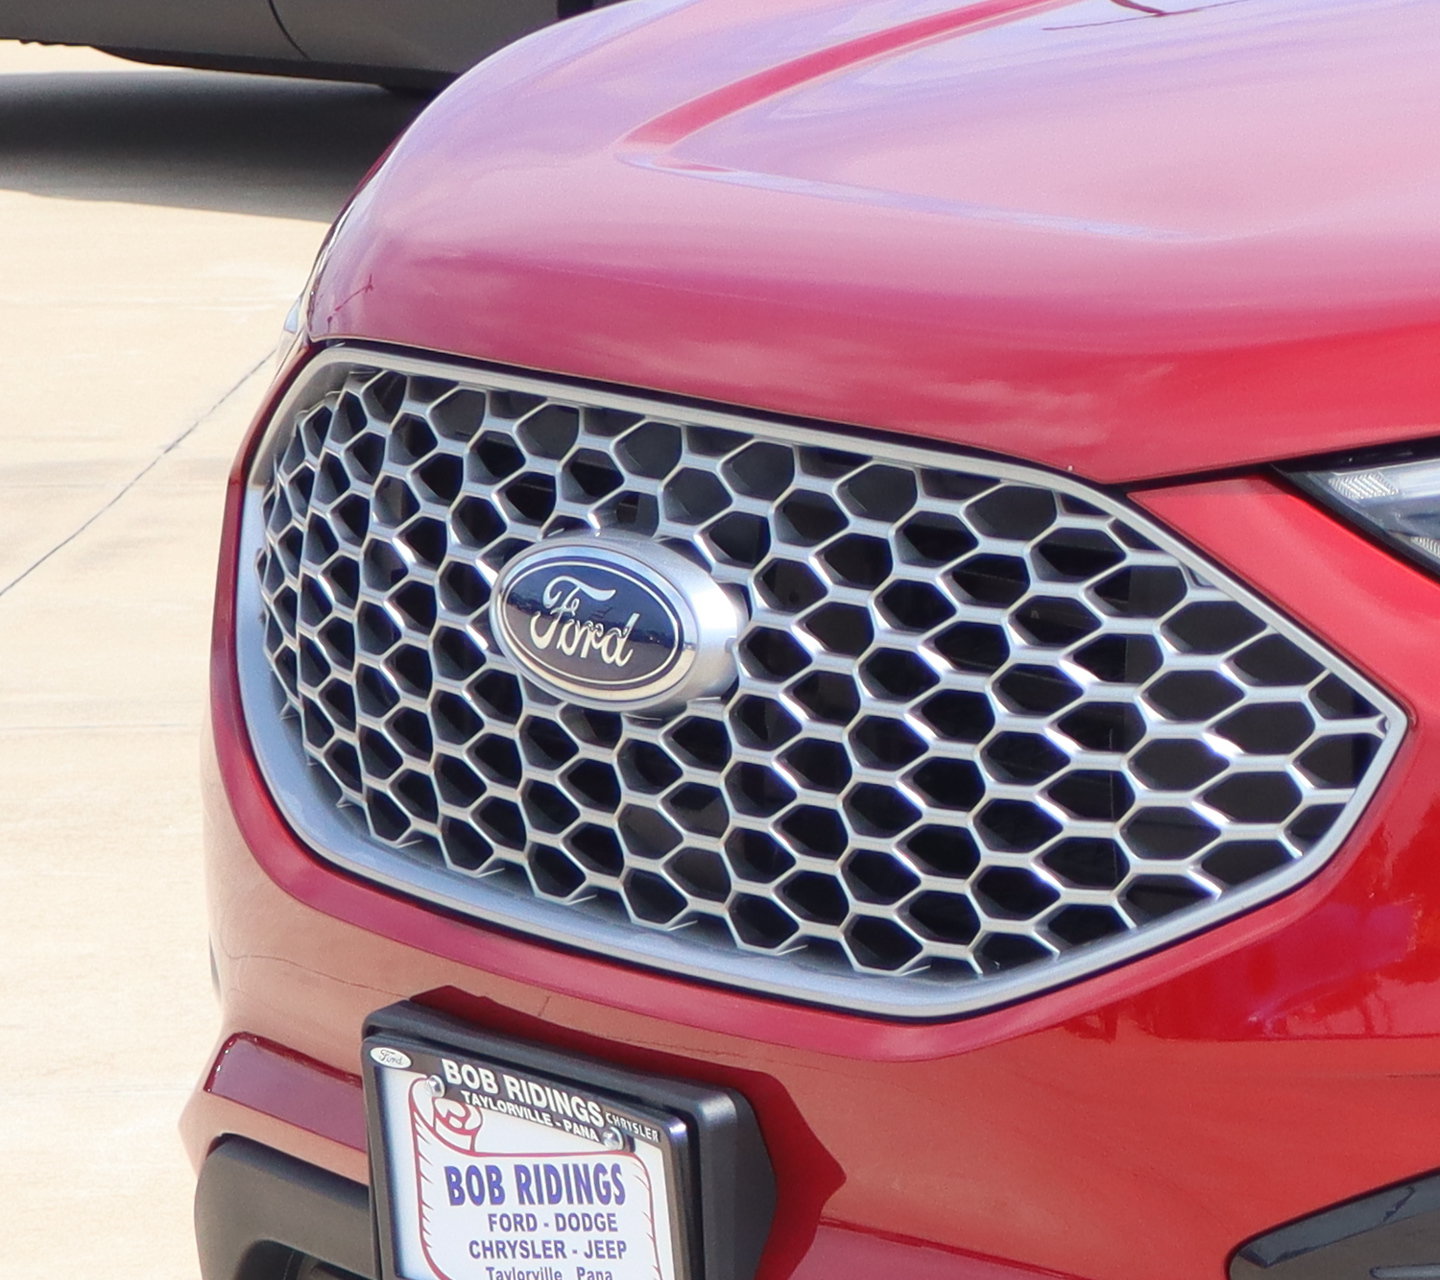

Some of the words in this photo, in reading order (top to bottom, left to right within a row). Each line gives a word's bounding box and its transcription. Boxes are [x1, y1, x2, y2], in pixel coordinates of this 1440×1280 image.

[529, 575, 640, 668] Ford
[378, 1049, 404, 1065] Ford
[442, 1058, 499, 1094] BOB
[503, 1074, 605, 1128] RIDINGS
[461, 1090, 553, 1127] TAYLORVILLE
[565, 1120, 599, 1142] PANA
[605, 1112, 660, 1144] CHRYSLER
[444, 1165, 505, 1207] BOB
[514, 1162, 625, 1206] RIDINGS
[488, 1213, 538, 1232] FORD
[554, 1212, 618, 1232] DODGE
[469, 1240, 567, 1259] CHRYSLER
[584, 1240, 627, 1260] JEEP
